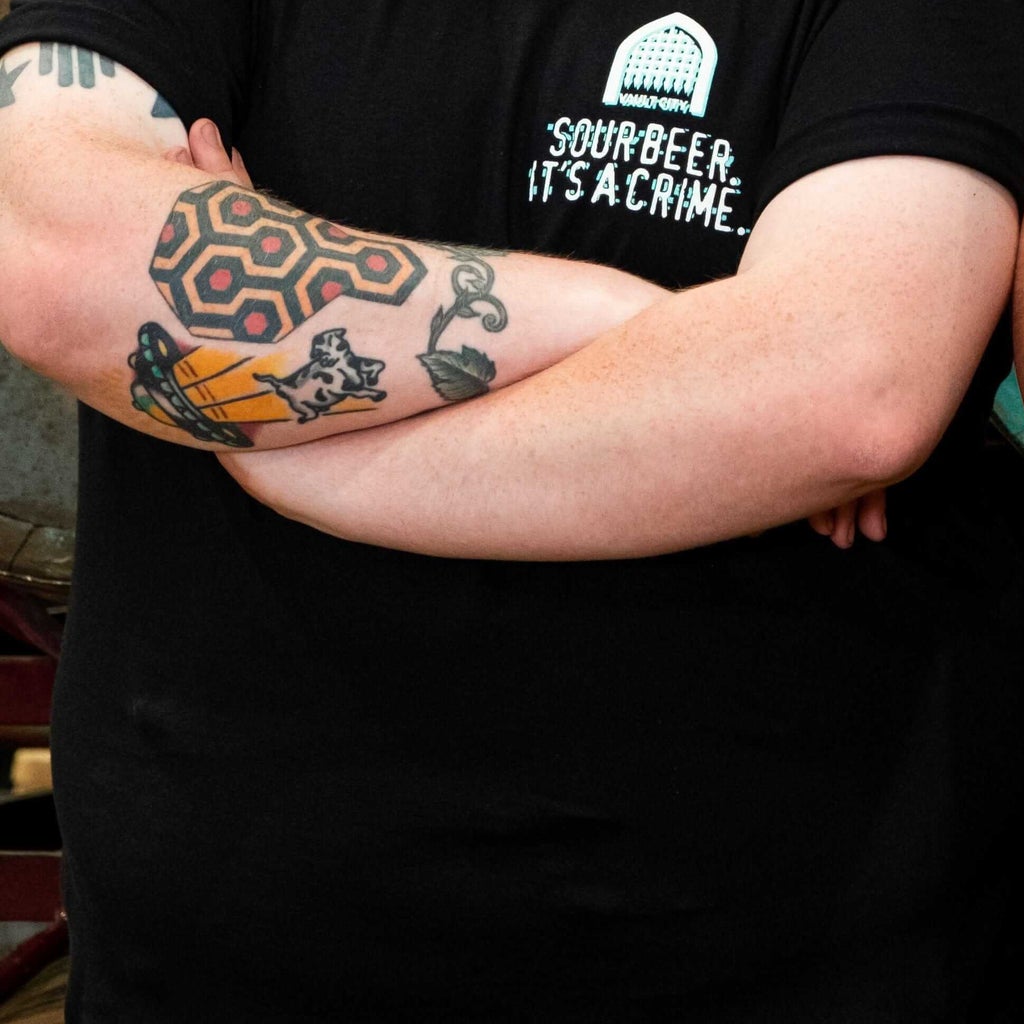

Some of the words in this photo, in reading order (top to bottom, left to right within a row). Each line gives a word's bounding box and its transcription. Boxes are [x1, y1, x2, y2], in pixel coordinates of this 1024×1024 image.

[620, 93, 657, 109] VAULT
[659, 97, 690, 114] CITY
[549, 117, 636, 161] SOUR
[640, 123, 741, 186] BEER.
[528, 160, 589, 202] IT'S
[591, 163, 619, 206] A
[626, 168, 748, 235] CRIME.
